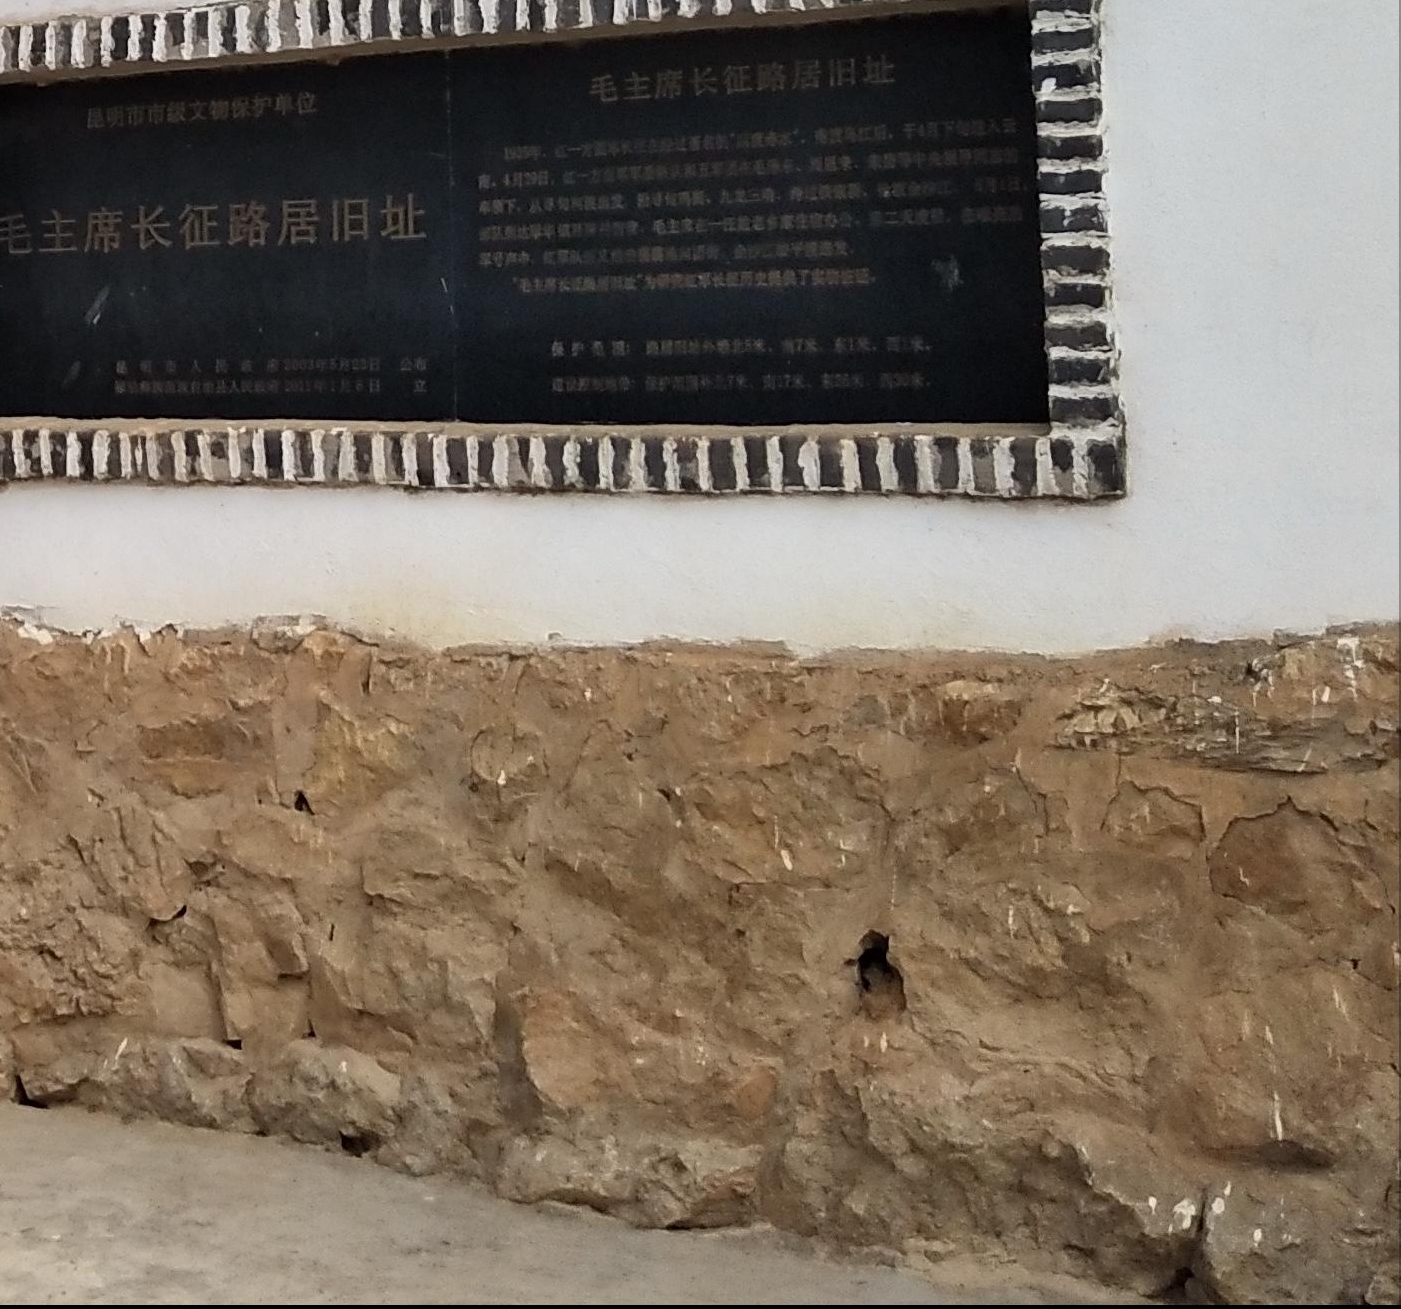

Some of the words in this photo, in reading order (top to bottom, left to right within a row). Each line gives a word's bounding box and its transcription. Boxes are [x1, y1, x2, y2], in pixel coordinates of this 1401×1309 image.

[590, 57, 895, 103] 毛主席长征路居旧址
[87, 92, 318, 130] 昆明市市级文物保护单位
